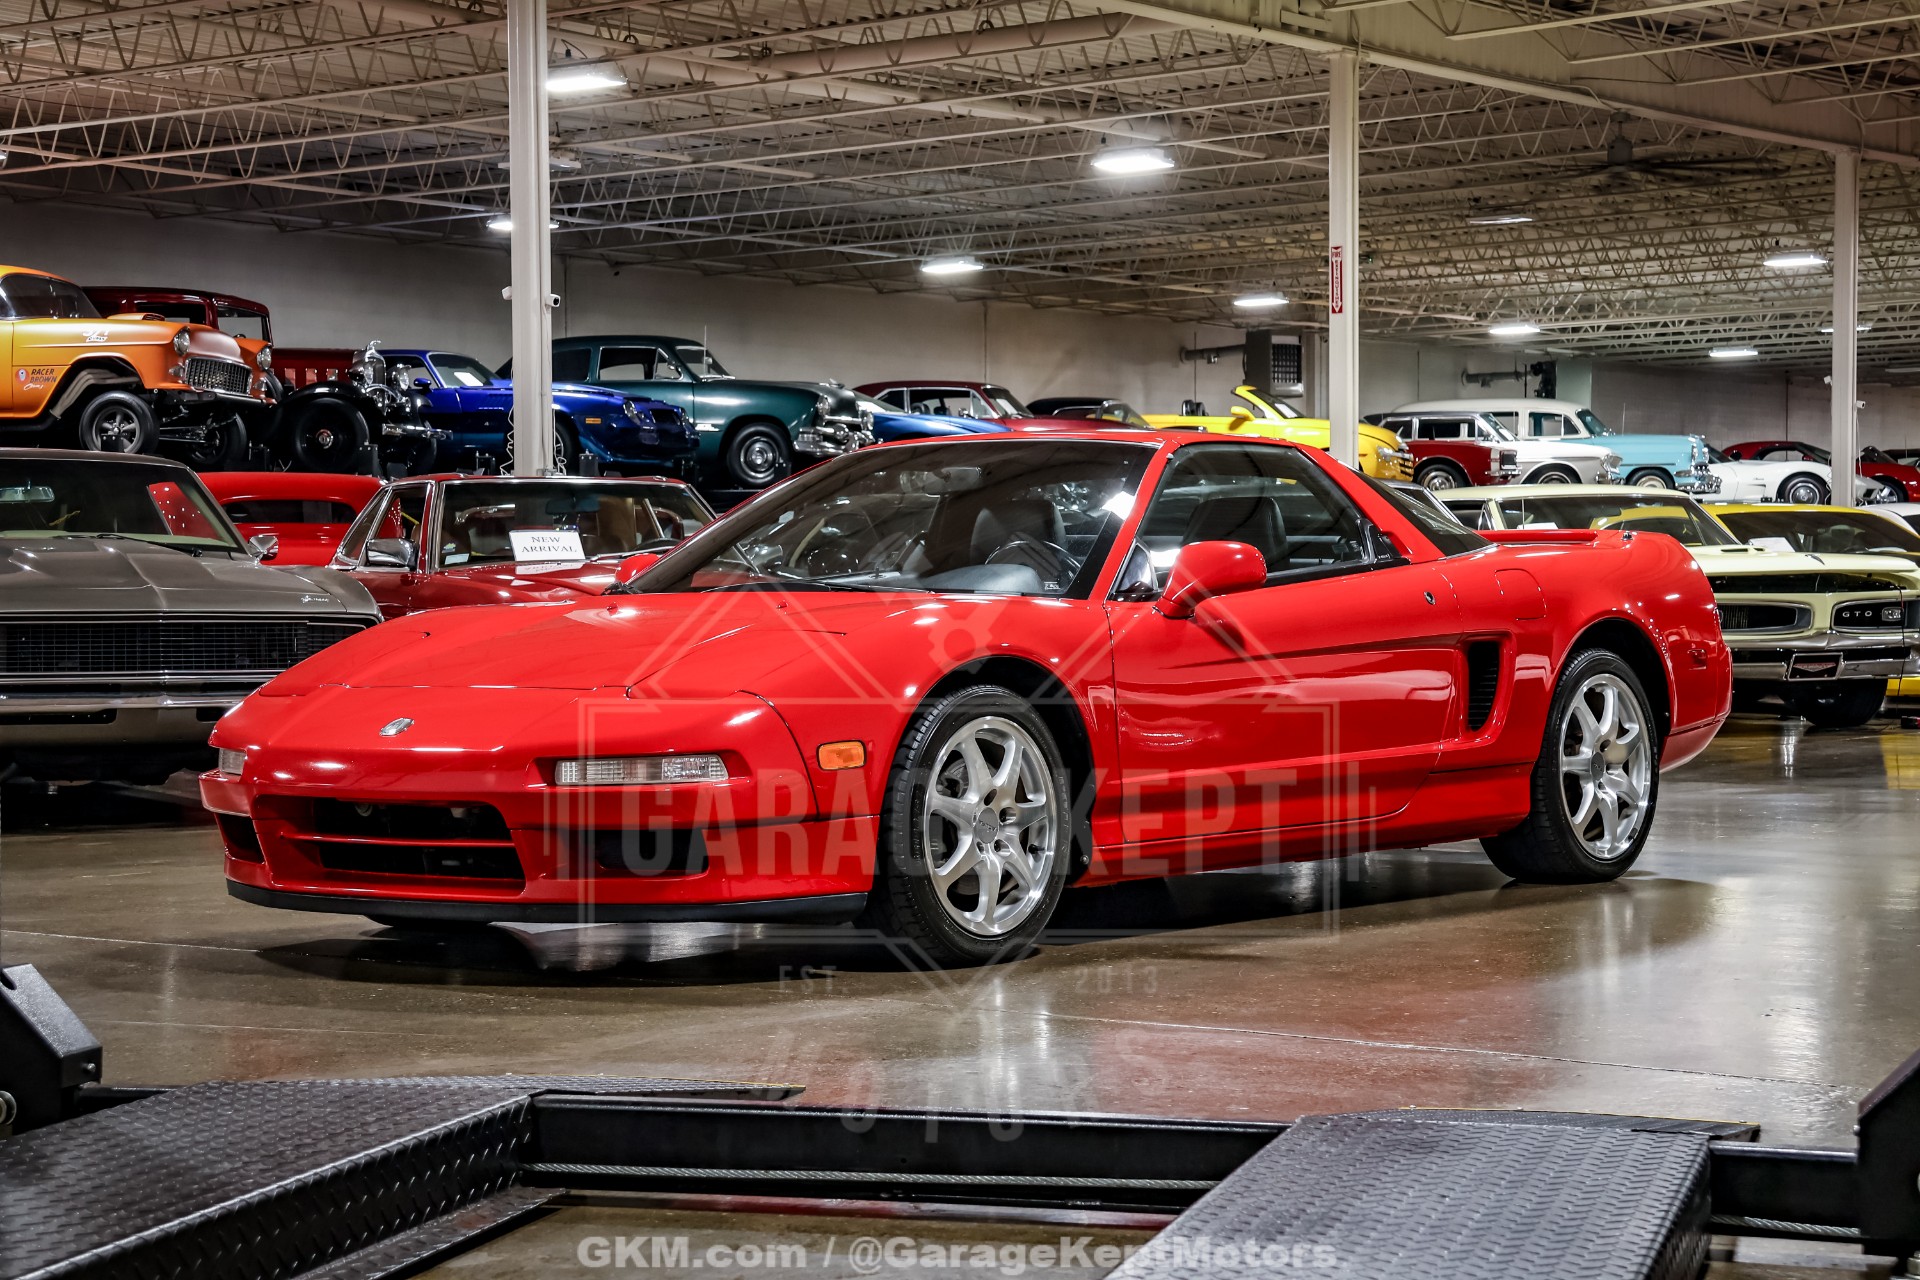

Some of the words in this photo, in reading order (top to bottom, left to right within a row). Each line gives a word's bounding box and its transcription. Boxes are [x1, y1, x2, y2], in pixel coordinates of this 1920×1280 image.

[30, 368, 55, 376] RACER
[521, 545, 578, 553] ARRIVAL
[1842, 610, 1873, 618] GTO
